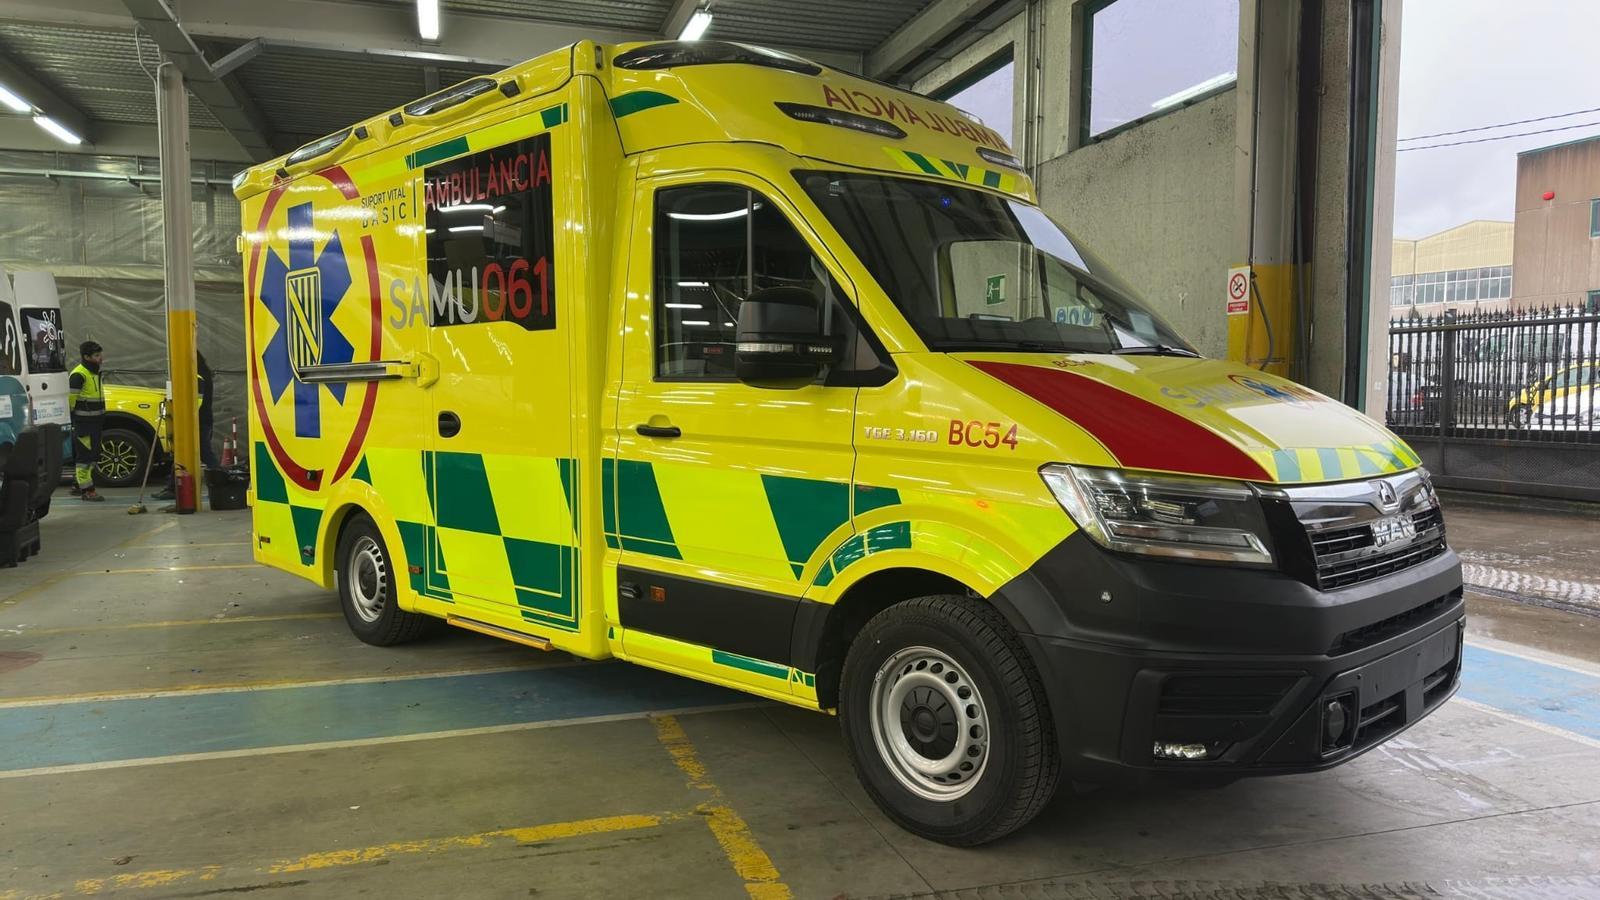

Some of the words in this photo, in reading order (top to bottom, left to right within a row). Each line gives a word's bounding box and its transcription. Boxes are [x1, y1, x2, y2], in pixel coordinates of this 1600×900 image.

[425, 149, 550, 211] AMBULÀNCIA
[361, 191, 386, 209] SUPORT
[387, 186, 406, 201] VITAL
[864, 426, 892, 441] TGE
[895, 428, 939, 443] 3.160
[948, 419, 1018, 450] BC54
[1371, 514, 1417, 548] MAN
